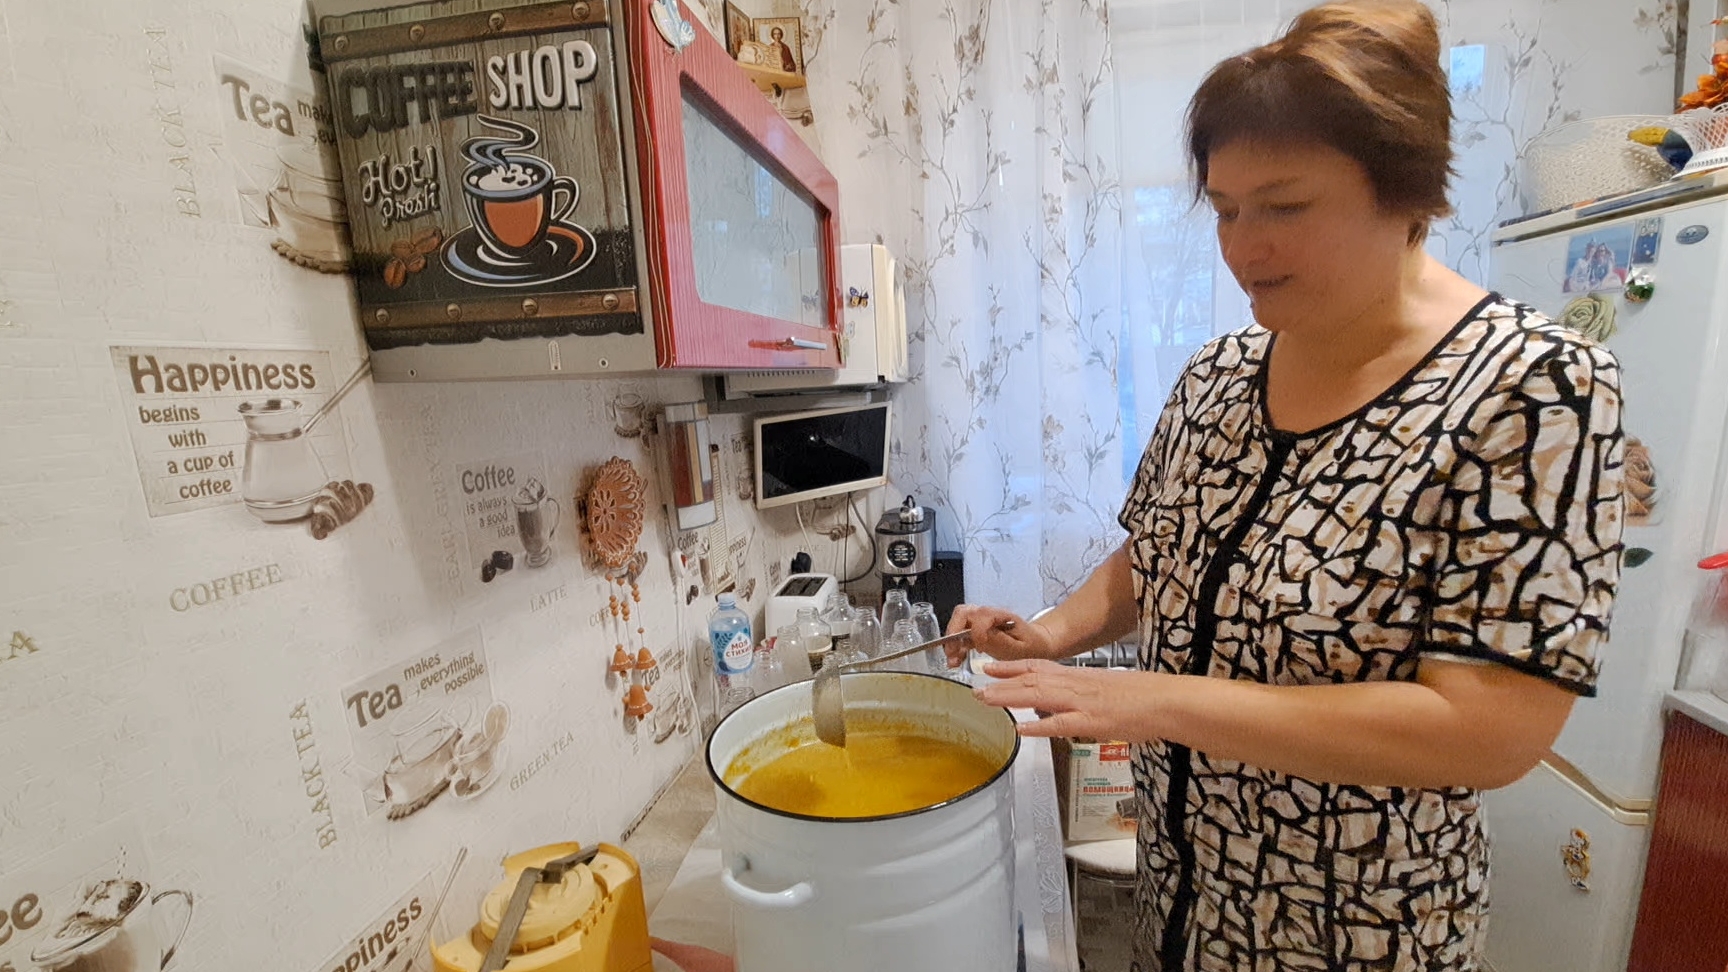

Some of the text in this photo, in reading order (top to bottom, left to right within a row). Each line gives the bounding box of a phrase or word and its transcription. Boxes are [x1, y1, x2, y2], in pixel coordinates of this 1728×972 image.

[221, 73, 295, 137] Tea
[339, 40, 597, 139] COFFEE SHOP
[297, 98, 334, 124] mak
[357, 144, 438, 206] Hot!
[128, 355, 316, 394] Happiness
[138, 404, 201, 424] begins
[168, 428, 207, 448] with
[167, 450, 235, 475] a cup of
[179, 478, 233, 499] coffee
[461, 464, 516, 495] Coffee
[465, 497, 507, 515] is always
[479, 508, 508, 528] a good
[497, 524, 516, 538] idea
[169, 562, 284, 612] COFFEE
[529, 583, 568, 613] LATTE
[402, 652, 442, 682] makes
[419, 650, 476, 691] everything
[443, 662, 486, 695] possible
[346, 682, 404, 729] Tea
[289, 697, 338, 850] BLACK TEA
[509, 731, 575, 792] GREEN TEA
